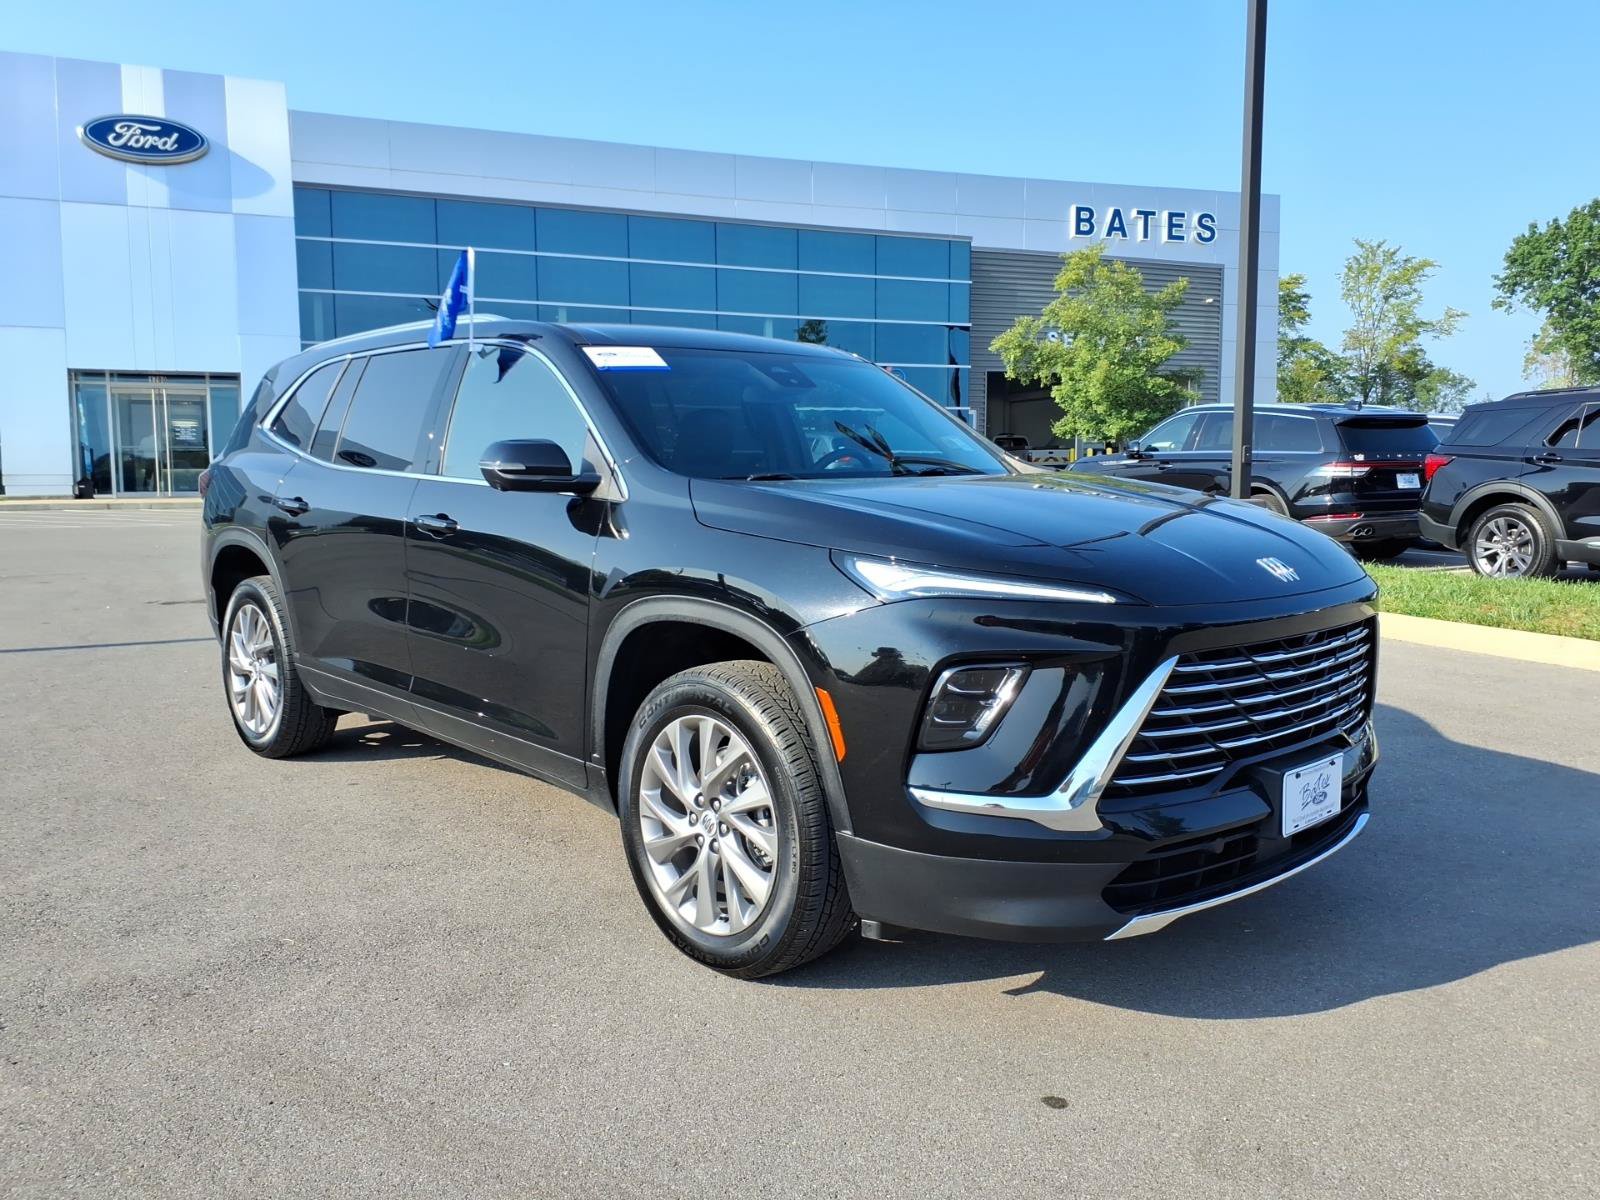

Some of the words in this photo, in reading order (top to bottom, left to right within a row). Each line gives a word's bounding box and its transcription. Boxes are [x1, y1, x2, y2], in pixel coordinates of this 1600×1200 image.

[108, 121, 179, 151] Ford
[1069, 204, 1217, 245] BATES
[638, 689, 735, 730] CONTINENTAL
